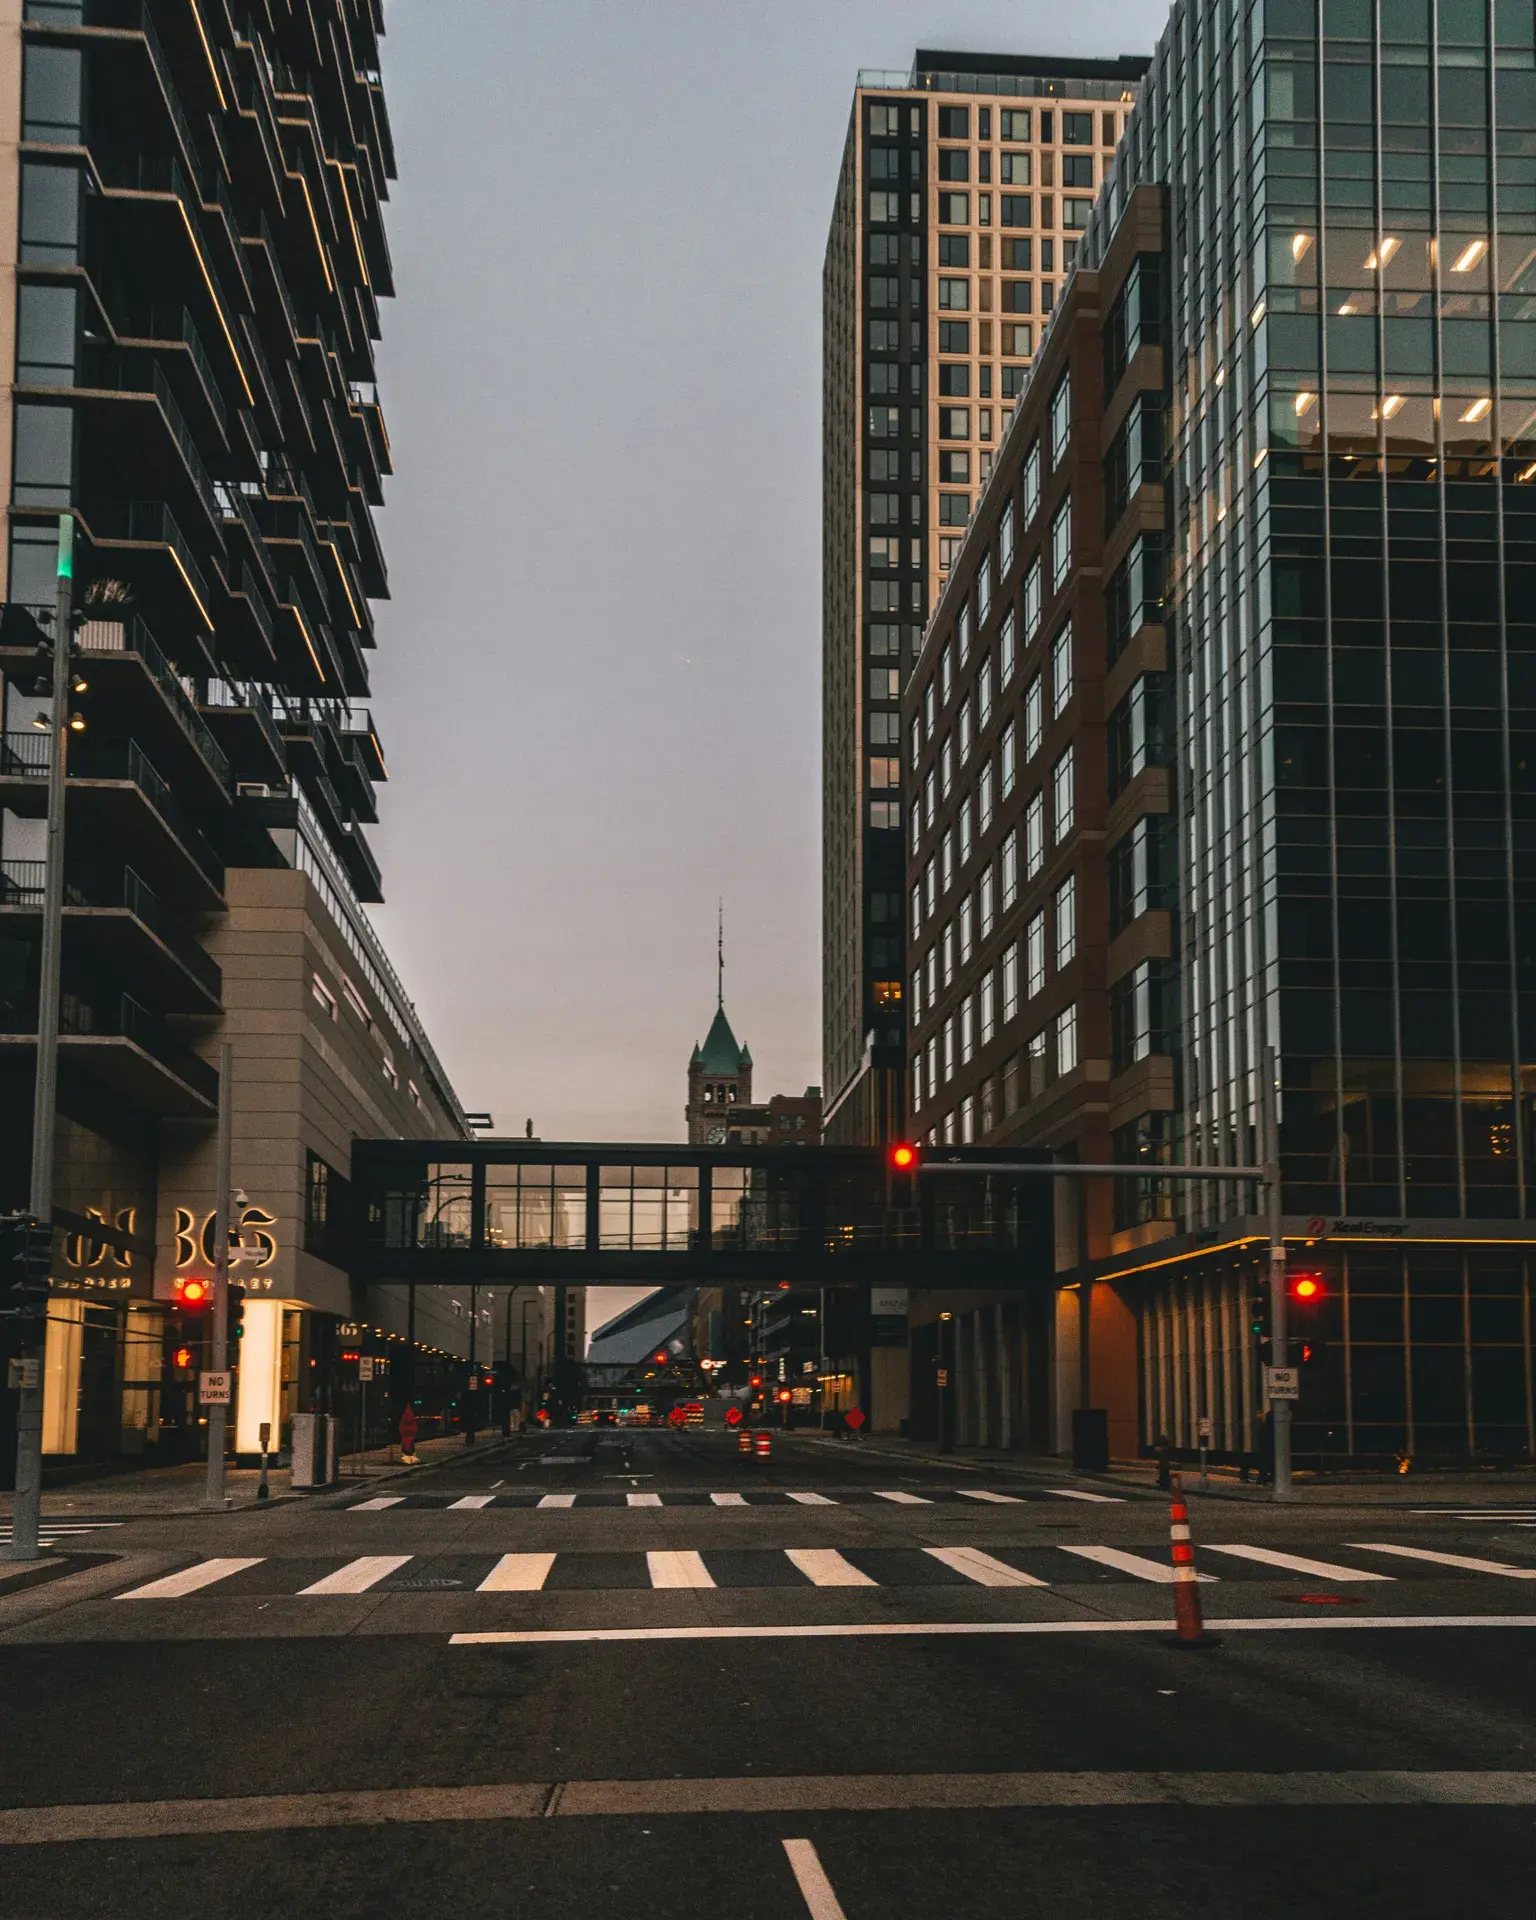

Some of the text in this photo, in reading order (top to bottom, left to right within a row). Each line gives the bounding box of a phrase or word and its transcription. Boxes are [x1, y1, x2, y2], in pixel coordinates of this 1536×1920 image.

[208, 1376, 224, 1386] NO
[1275, 1372, 1290, 1382] NO
[200, 1390, 230, 1399] TURNS
[1267, 1386, 1297, 1395] TURNS
